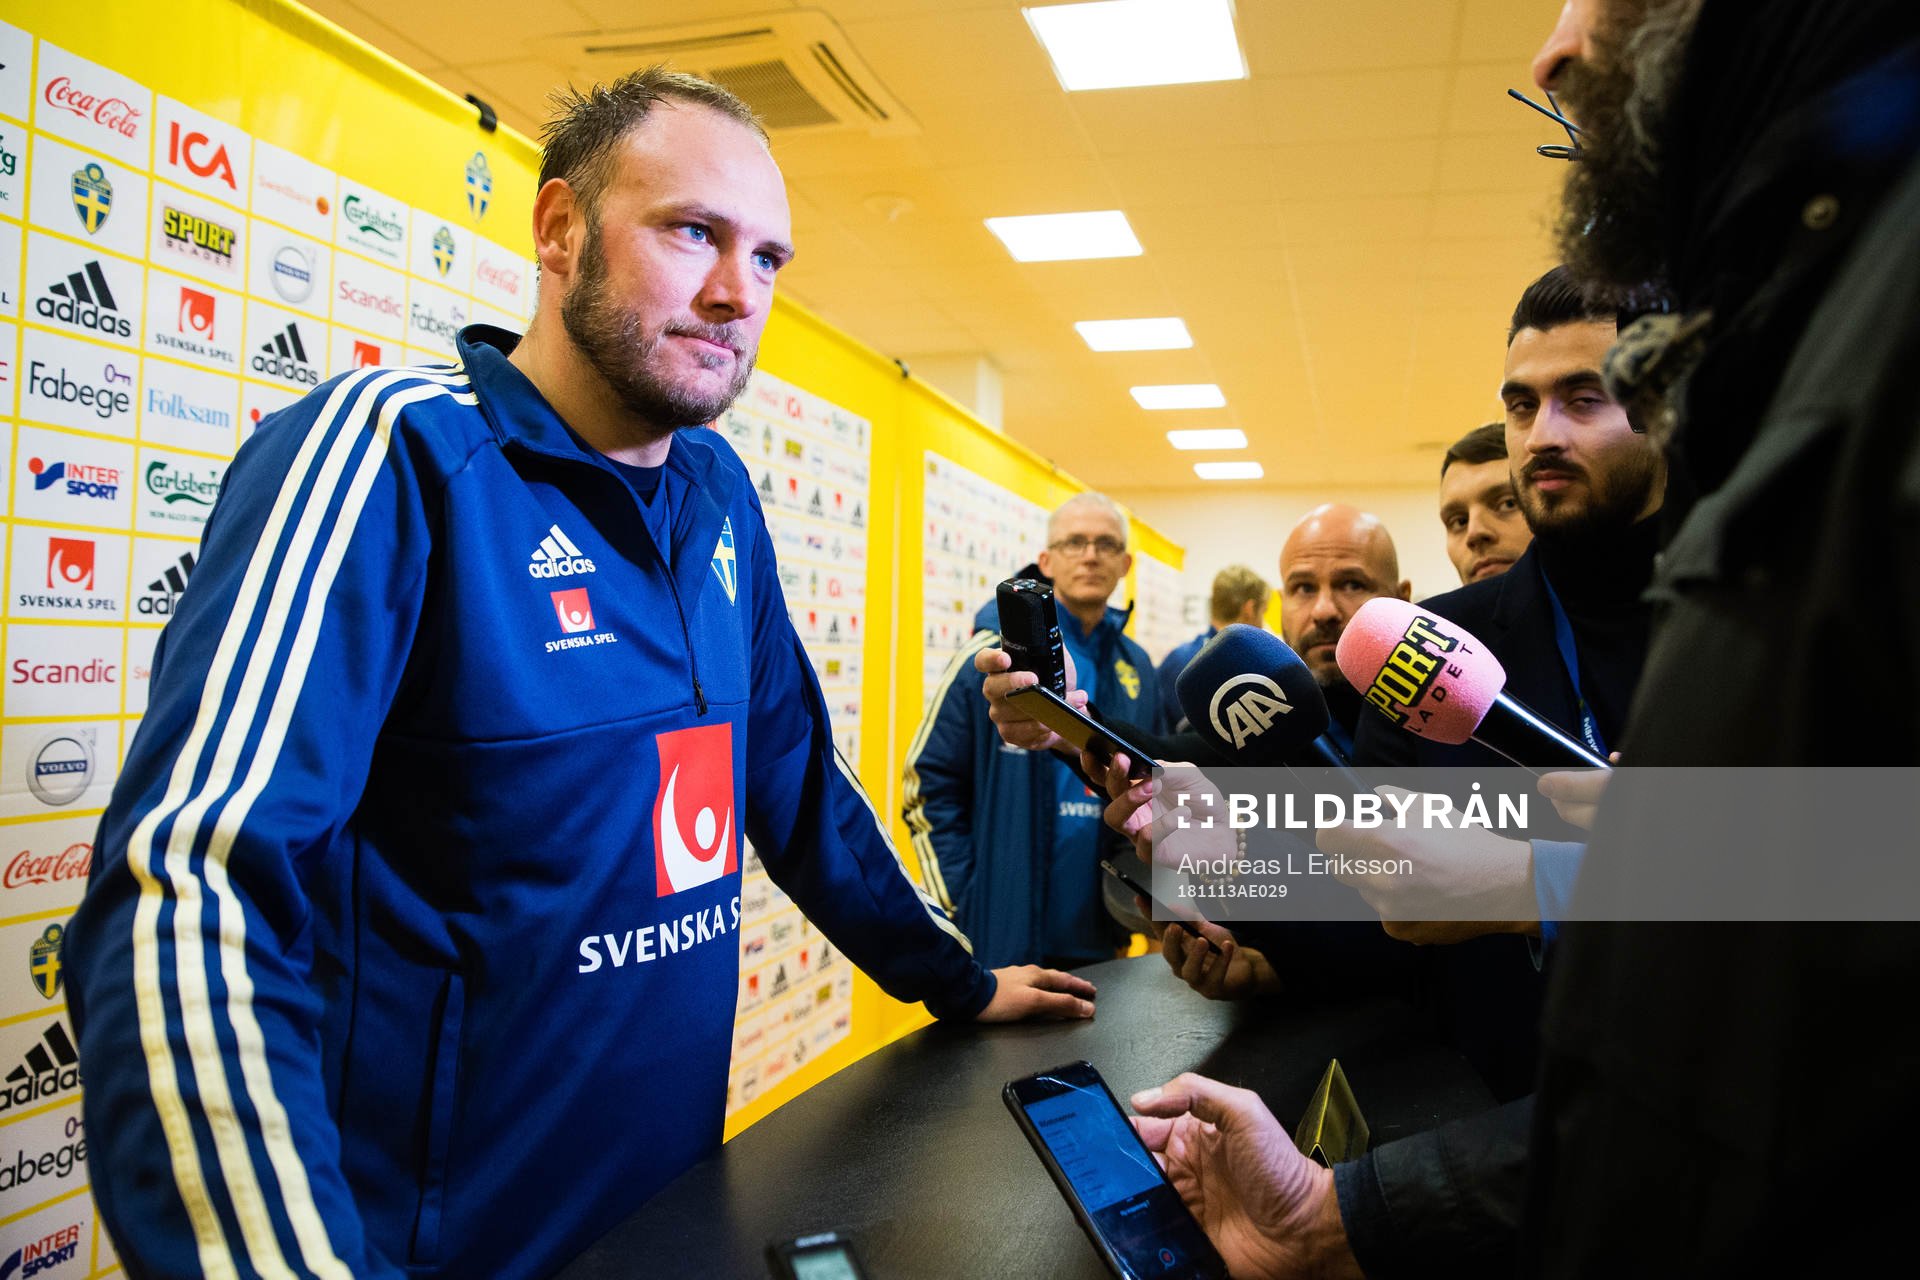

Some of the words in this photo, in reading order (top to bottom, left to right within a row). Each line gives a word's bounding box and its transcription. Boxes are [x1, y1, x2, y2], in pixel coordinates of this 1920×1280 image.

[44, 76, 142, 139] Coca-Cola
[169, 120, 237, 190] ICA
[163, 205, 235, 258] SPORT
[36, 296, 131, 337] adidas
[338, 280, 403, 318] Scandic
[410, 302, 461, 346] Fabeg
[155, 333, 205, 356] SVENSKA
[209, 347, 234, 363] SPEL
[29, 360, 130, 418] Fabege
[251, 354, 319, 386] adidas
[148, 387, 230, 429] Folksam
[66, 480, 118, 501] SPORT
[67, 463, 119, 485] INTER
[528, 557, 596, 579] adidas
[19, 595, 83, 609] SVENSKA
[87, 597, 117, 611] SPEL
[137, 592, 175, 615] adi
[545, 635, 594, 653] SVENSKA
[594, 633, 618, 645] SPEL
[12, 658, 116, 684] Scandic
[1365, 616, 1459, 726] PORT
[1407, 643, 1473, 733] LADET
[1225, 690, 1294, 751] AA
[38, 762, 87, 775] VOLVO
[578, 904, 726, 974] SVENSKA
[0, 1067, 83, 1111] adida
[0, 1138, 89, 1192] abege
[22, 1240, 78, 1280] SPORT
[23, 1224, 79, 1262] INTER
